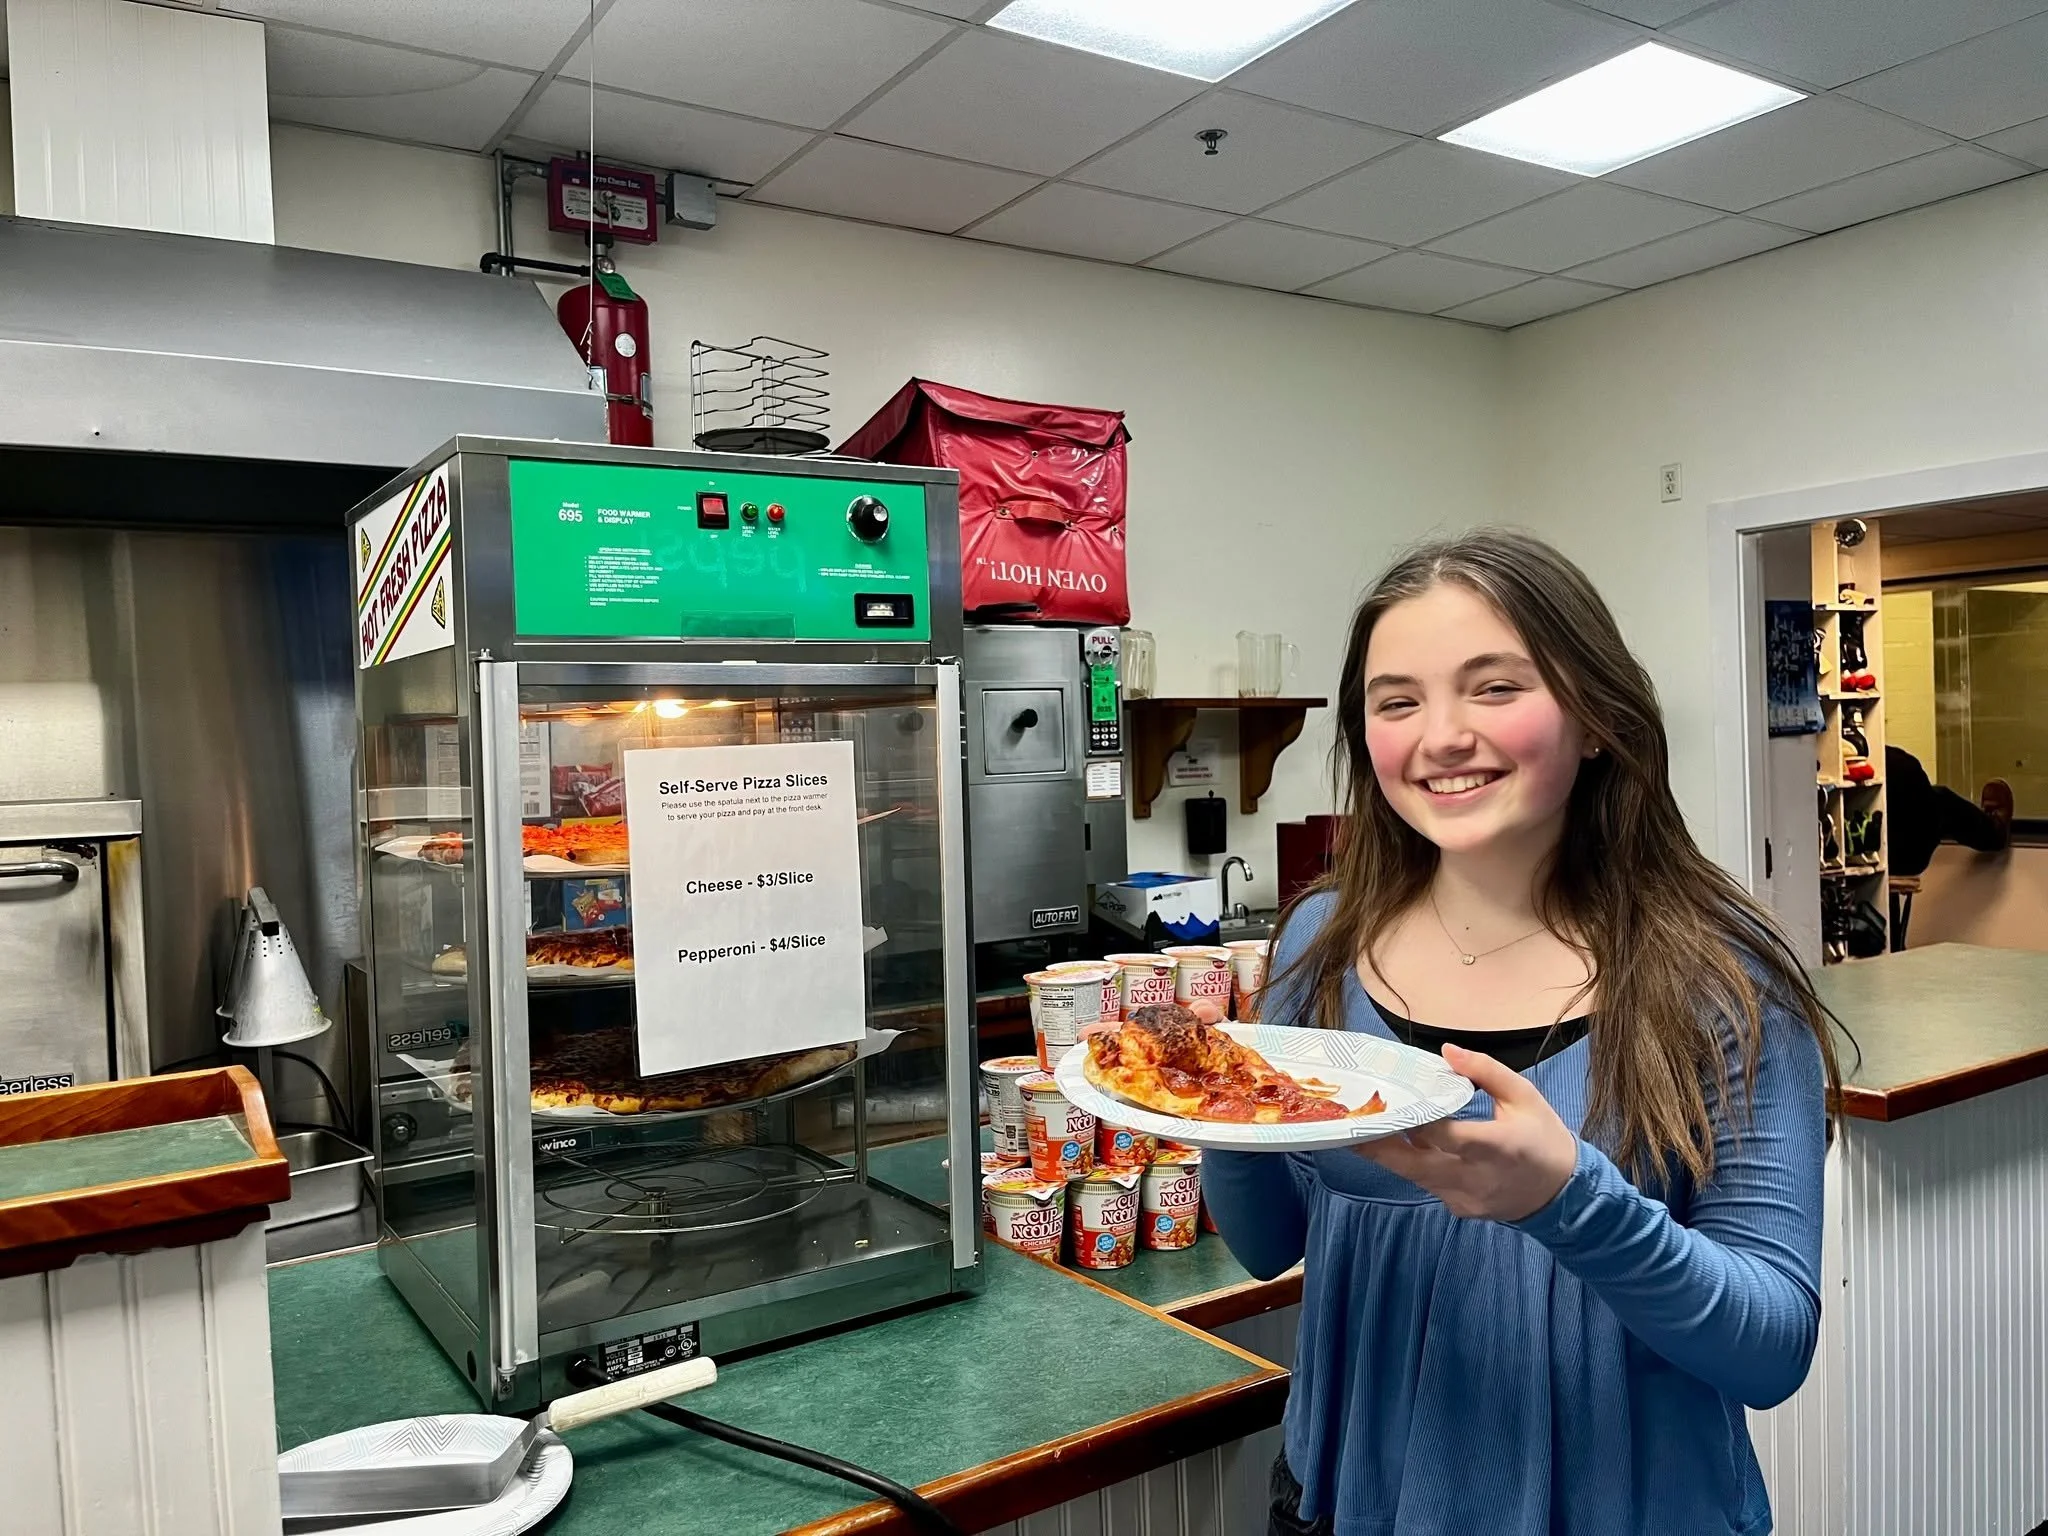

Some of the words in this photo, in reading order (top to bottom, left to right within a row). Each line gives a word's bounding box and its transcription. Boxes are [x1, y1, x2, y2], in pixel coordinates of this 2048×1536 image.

[558, 508, 583, 522] 695
[619, 510, 651, 518] WARMER
[361, 599, 378, 662] HOT
[380, 538, 412, 627] FRESH
[411, 475, 448, 567] PIZZA
[990, 561, 1042, 586] HOT!
[1048, 568, 1107, 593] OVEN
[1092, 636, 1112, 644] PULL
[660, 780, 738, 794] Self-Serve
[743, 777, 780, 789] Pizza
[786, 774, 827, 787] Slices
[718, 798, 743, 806] spatula
[700, 812, 714, 820] your
[687, 880, 742, 894] Cheese
[757, 872, 813, 888] $3/Slice
[1035, 908, 1078, 924] AUTOFRY
[679, 941, 755, 963] Pepperoni
[770, 935, 825, 952] $4/Slice
[1144, 978, 1173, 992] CUP
[1204, 971, 1231, 985] CUP
[1102, 986, 1119, 1001] UP
[0, 1076, 70, 1094] eerless
[540, 1137, 576, 1150] winco
[1026, 1207, 1059, 1225] CUP
[1023, 1239, 1051, 1247] CHICKEN
[606, 1356, 626, 1366] WATTS
[606, 1364, 624, 1373] AMPS
